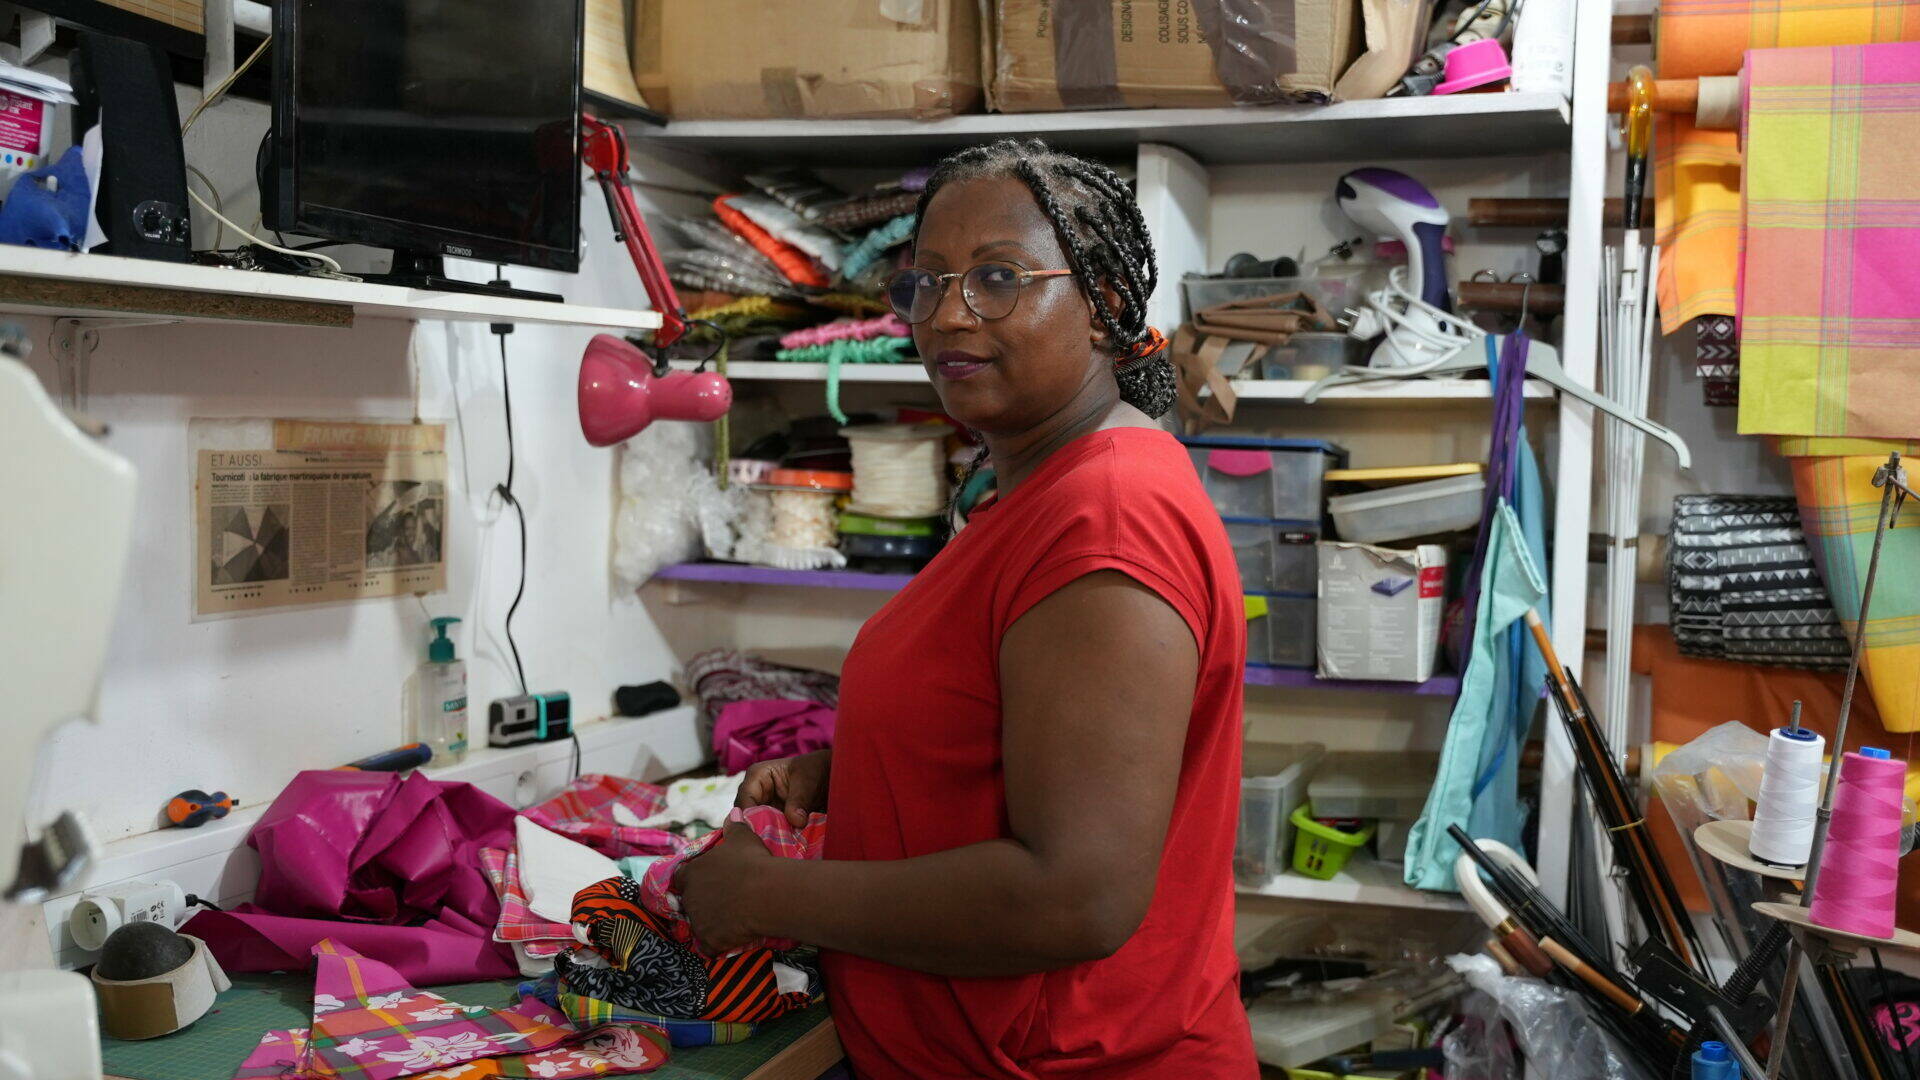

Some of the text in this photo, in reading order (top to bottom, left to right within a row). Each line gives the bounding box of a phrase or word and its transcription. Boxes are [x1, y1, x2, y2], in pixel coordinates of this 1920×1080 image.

[1121, 0, 1133, 43] DESIGNA
[1176, 17, 1189, 44] SOUS
[211, 454, 225, 466] ET
[211, 472, 245, 481] Tournicoti
[252, 472, 260, 481] la
[260, 472, 288, 482] fabrique
